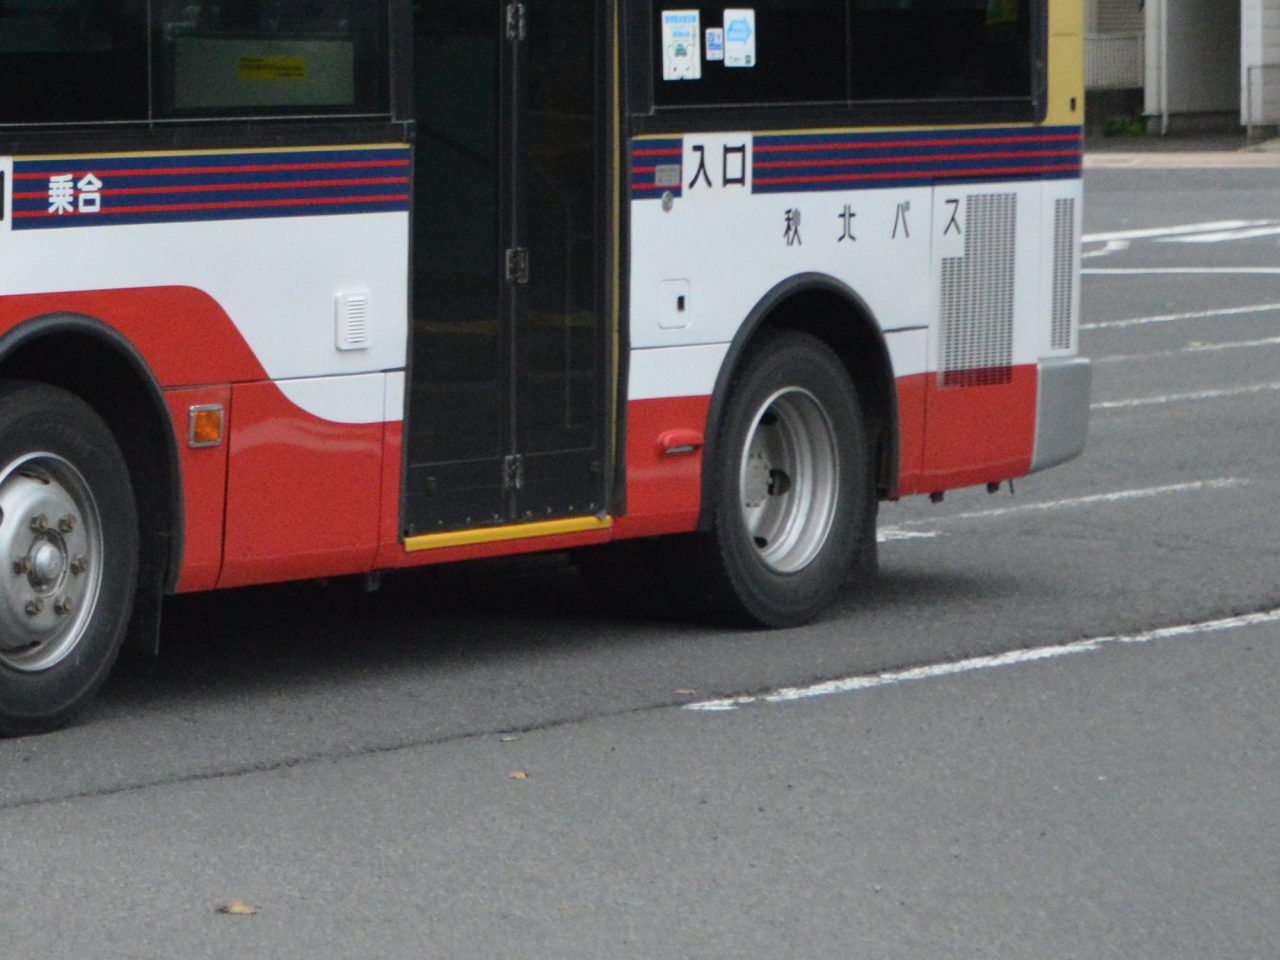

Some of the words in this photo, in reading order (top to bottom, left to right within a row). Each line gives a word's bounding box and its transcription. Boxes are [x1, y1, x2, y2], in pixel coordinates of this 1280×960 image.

[688, 143, 746, 190] 入口
[47, 173, 103, 215] 乗合
[782, 198, 961, 247] 秋北バス
